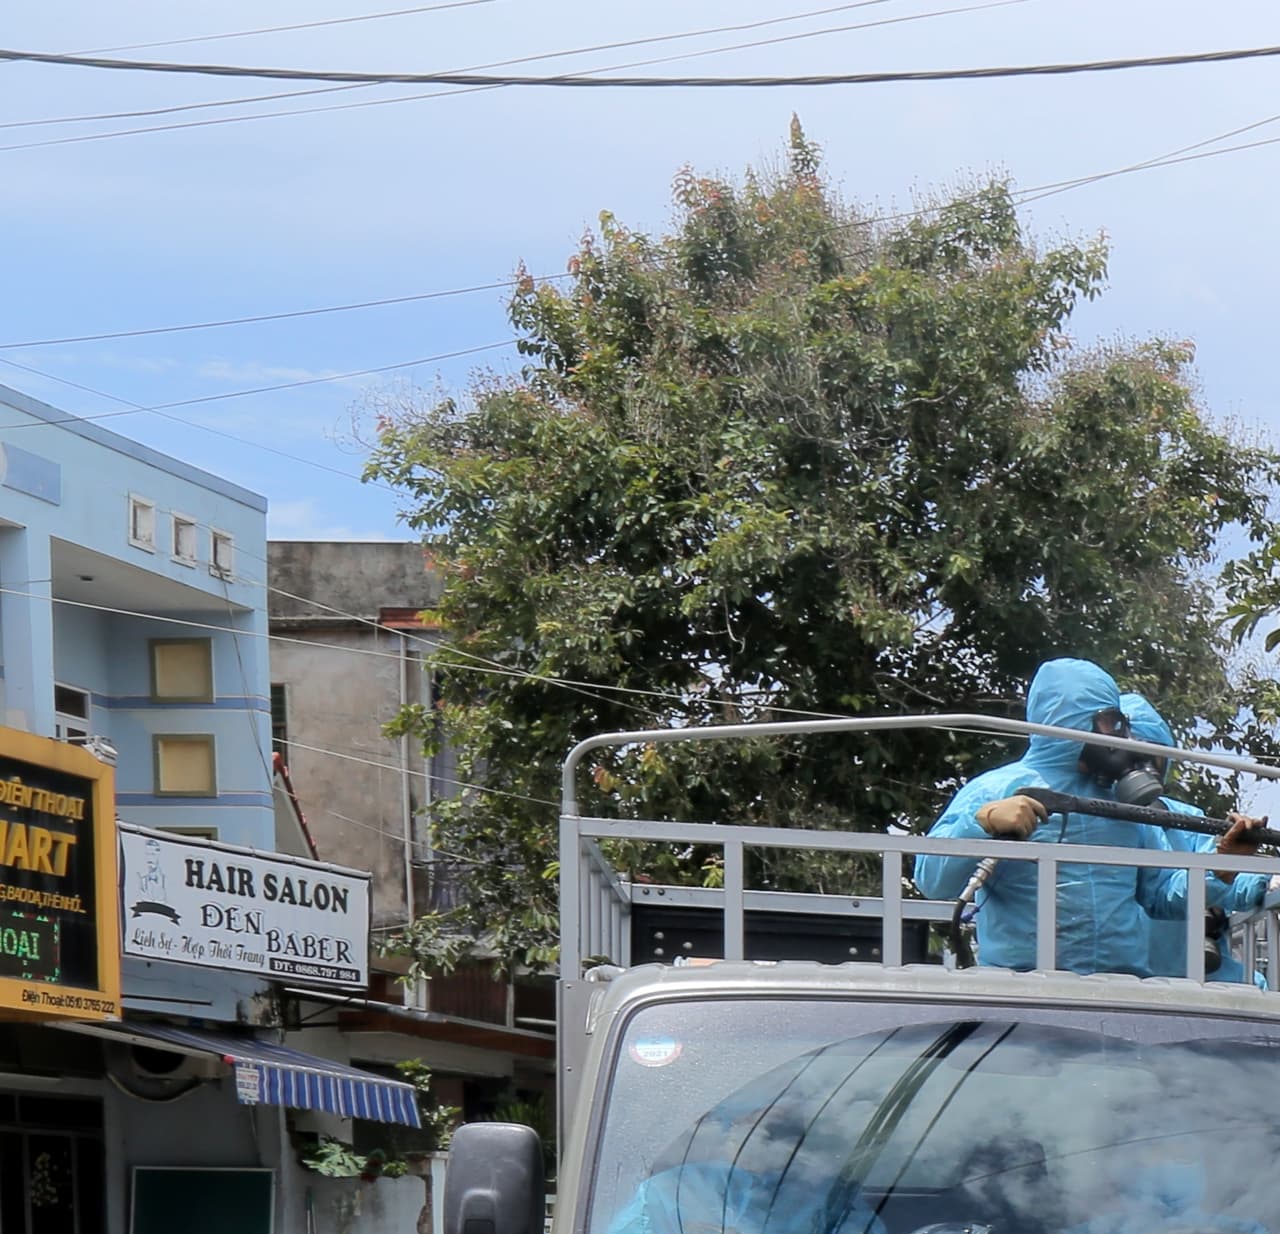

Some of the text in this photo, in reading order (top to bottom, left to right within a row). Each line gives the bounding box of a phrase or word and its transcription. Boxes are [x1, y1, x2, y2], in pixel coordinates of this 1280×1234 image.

[33, 789, 85, 823] THOẠI
[185, 859, 349, 913] HAIR SALON
[236, 944, 264, 967] Trang
[265, 930, 352, 964] BABER
